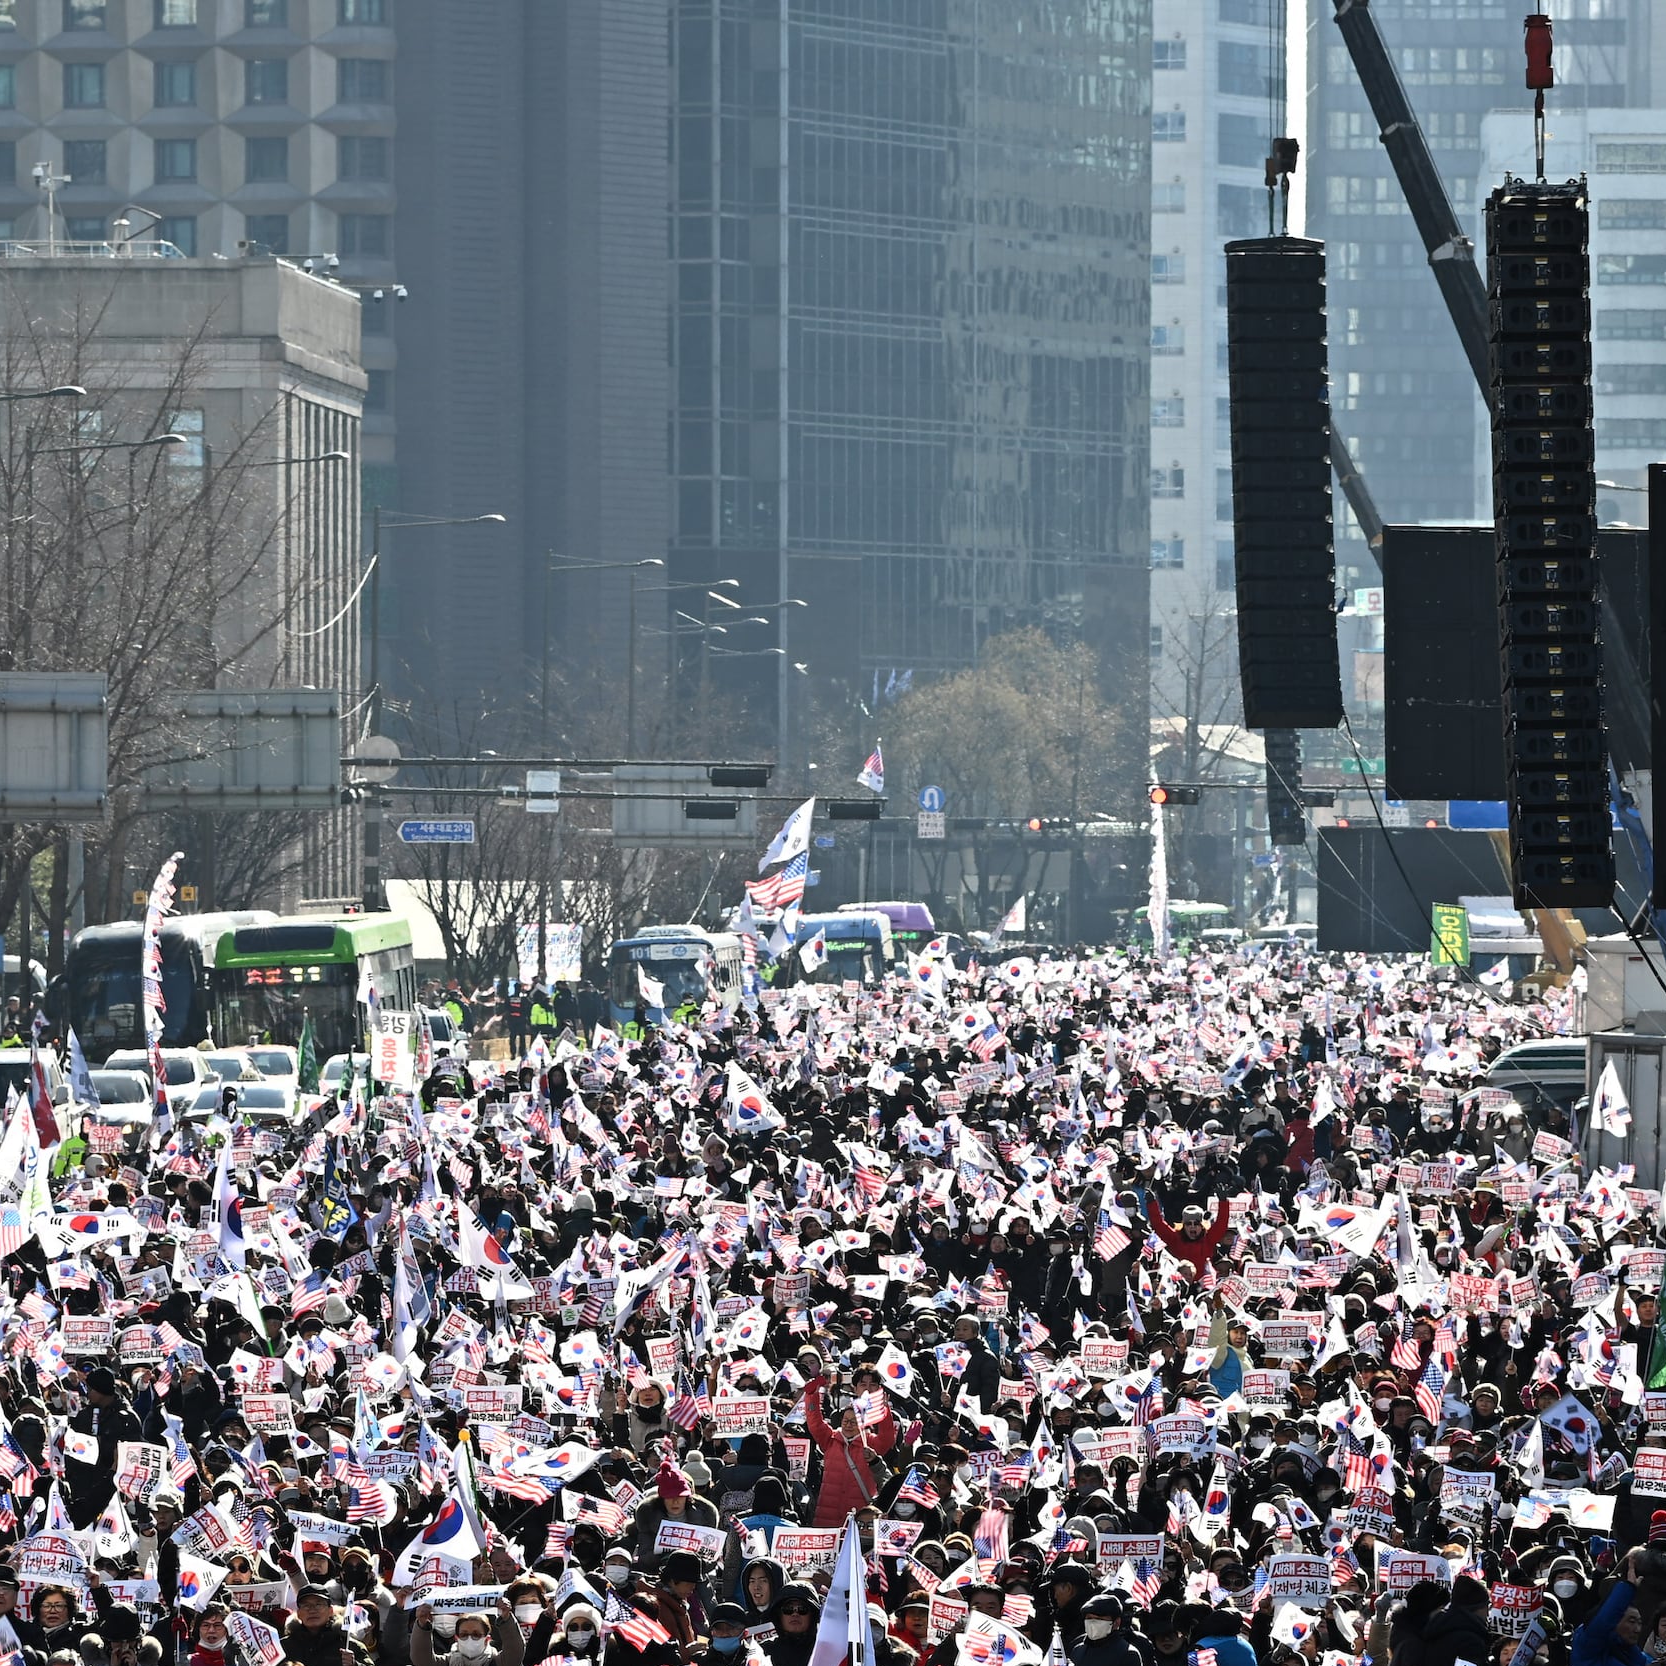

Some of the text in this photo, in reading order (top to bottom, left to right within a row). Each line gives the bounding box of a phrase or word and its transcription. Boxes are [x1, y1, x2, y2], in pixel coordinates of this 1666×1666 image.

[1457, 1276, 1492, 1289] STOP
[777, 1535, 834, 1548] 새해 소원은
[1103, 1542, 1158, 1556] 새해 소원은
[1274, 1562, 1328, 1578] 새해 소원은
[433, 1595, 498, 1607] 싸우겠습니다
[1493, 1584, 1543, 1605] 부정선거
[1501, 1606, 1529, 1619] OUT
